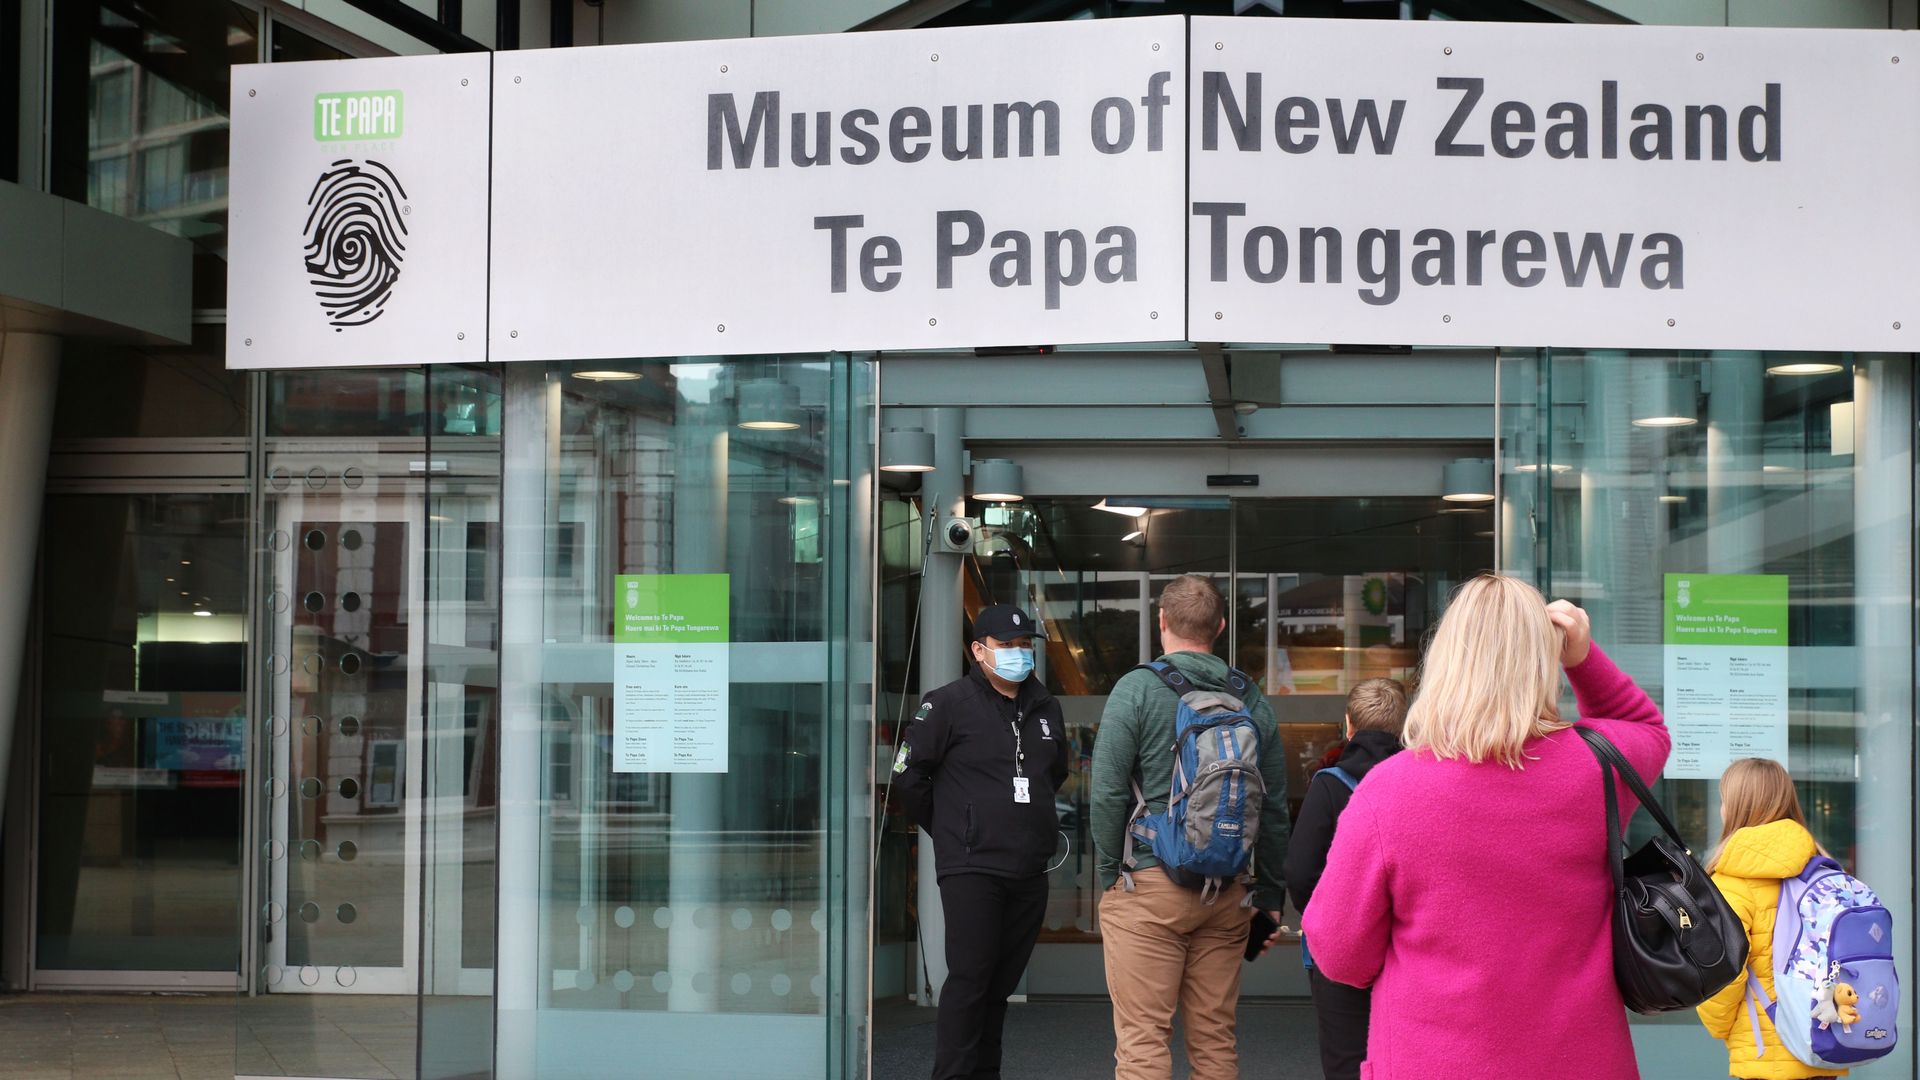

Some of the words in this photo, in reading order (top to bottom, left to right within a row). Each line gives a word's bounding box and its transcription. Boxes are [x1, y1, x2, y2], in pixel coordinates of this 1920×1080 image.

[318, 98, 341, 136] TE
[346, 95, 396, 135] PAPA
[707, 91, 1060, 170] Museum
[1091, 71, 1171, 154] of
[1202, 71, 1407, 155] New
[1434, 77, 1781, 162] Zealand
[814, 214, 902, 293] Te
[936, 210, 1138, 310] Papa
[1192, 202, 1685, 306] Tongarewa
